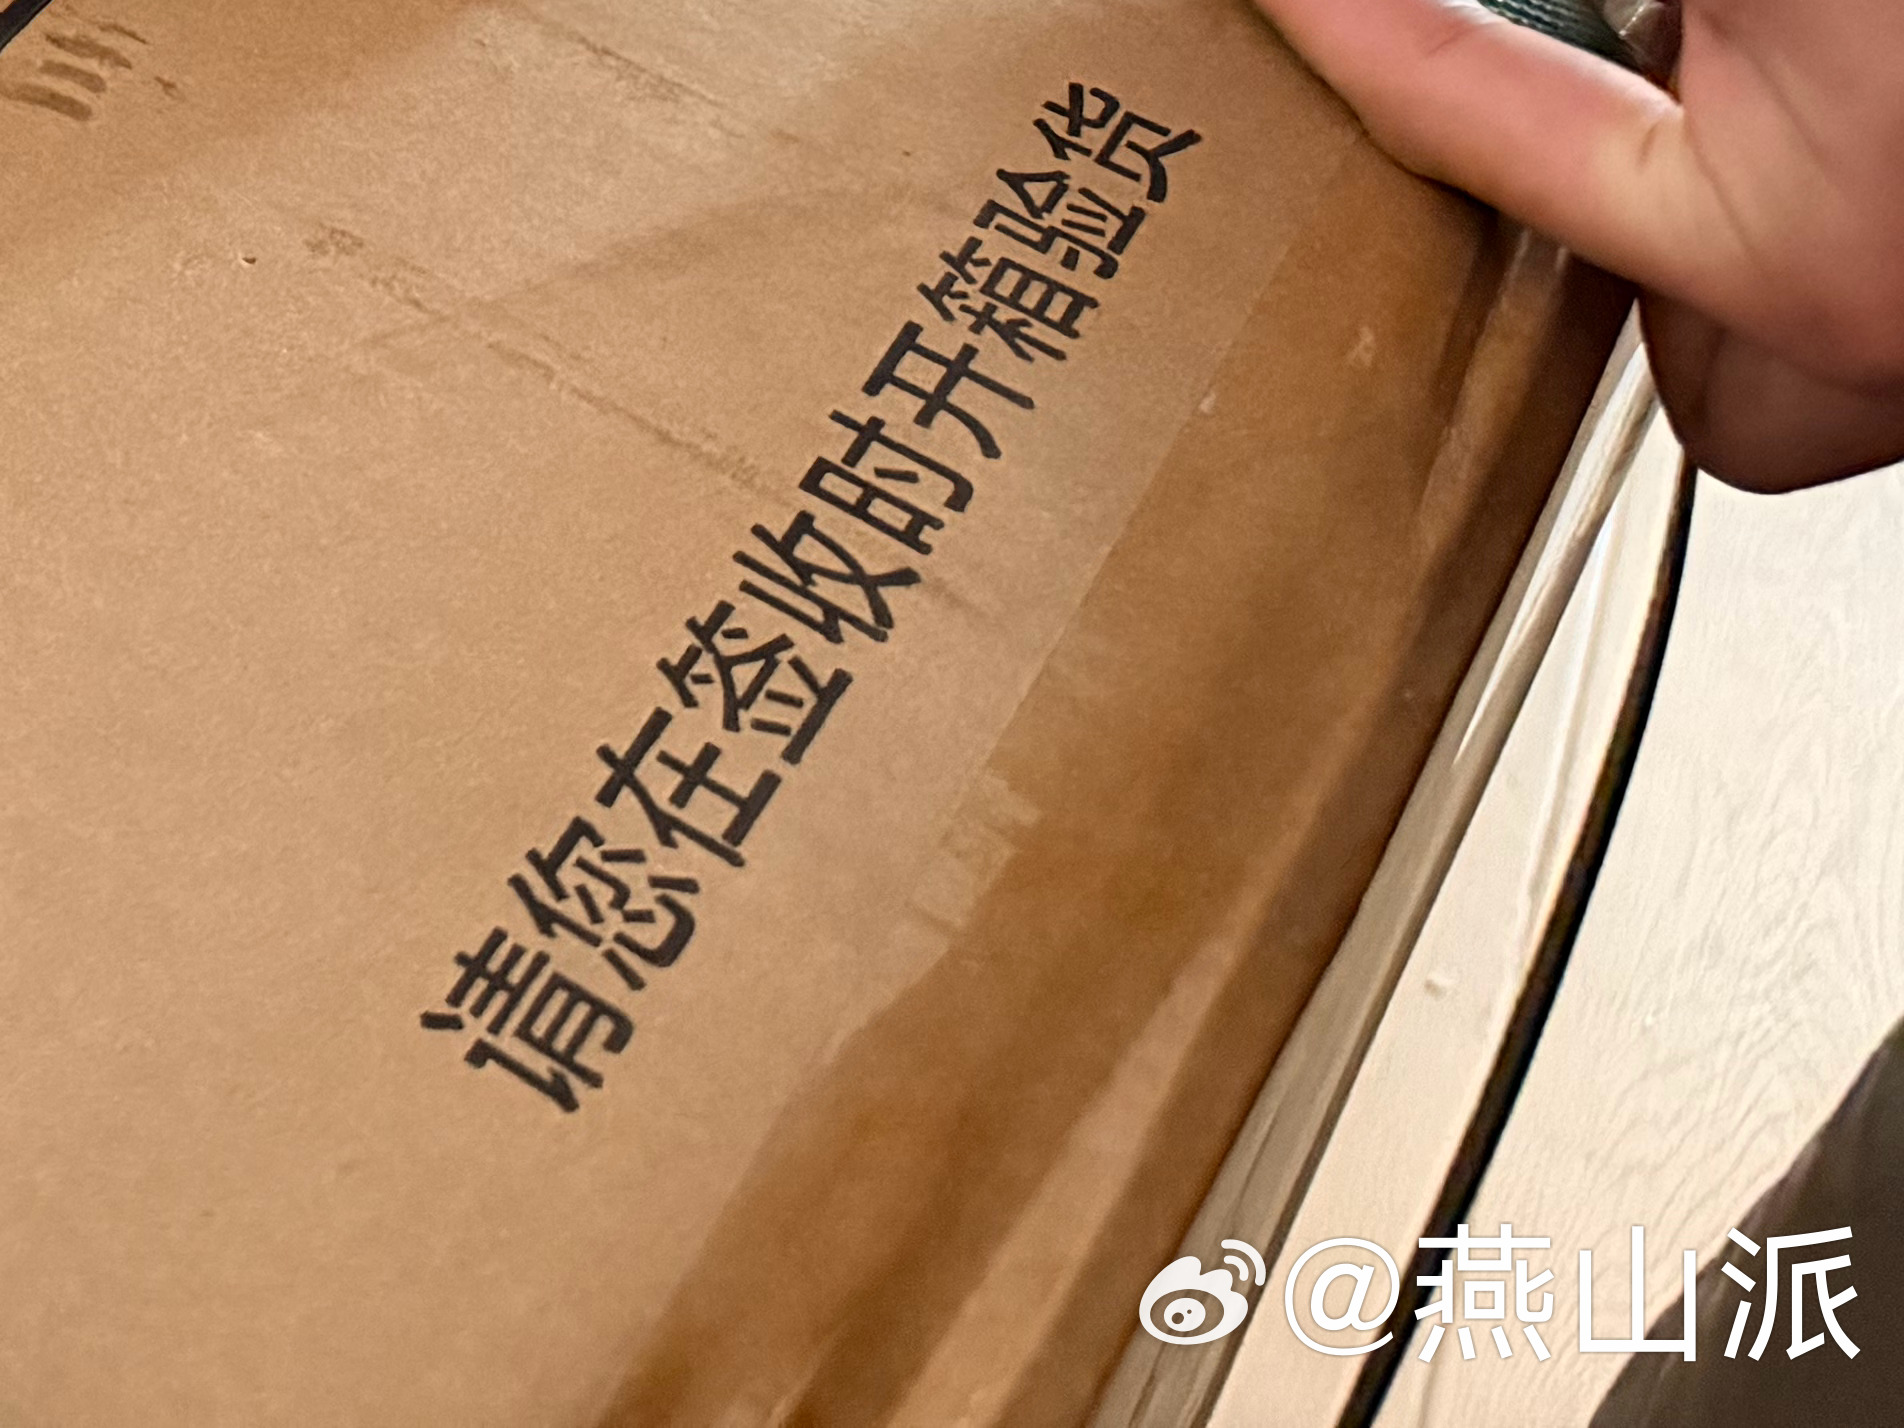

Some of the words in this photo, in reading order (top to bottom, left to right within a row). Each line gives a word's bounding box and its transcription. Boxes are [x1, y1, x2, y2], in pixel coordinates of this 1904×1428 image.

[420, 81, 1203, 1114] 请您在签收时开箱验货
